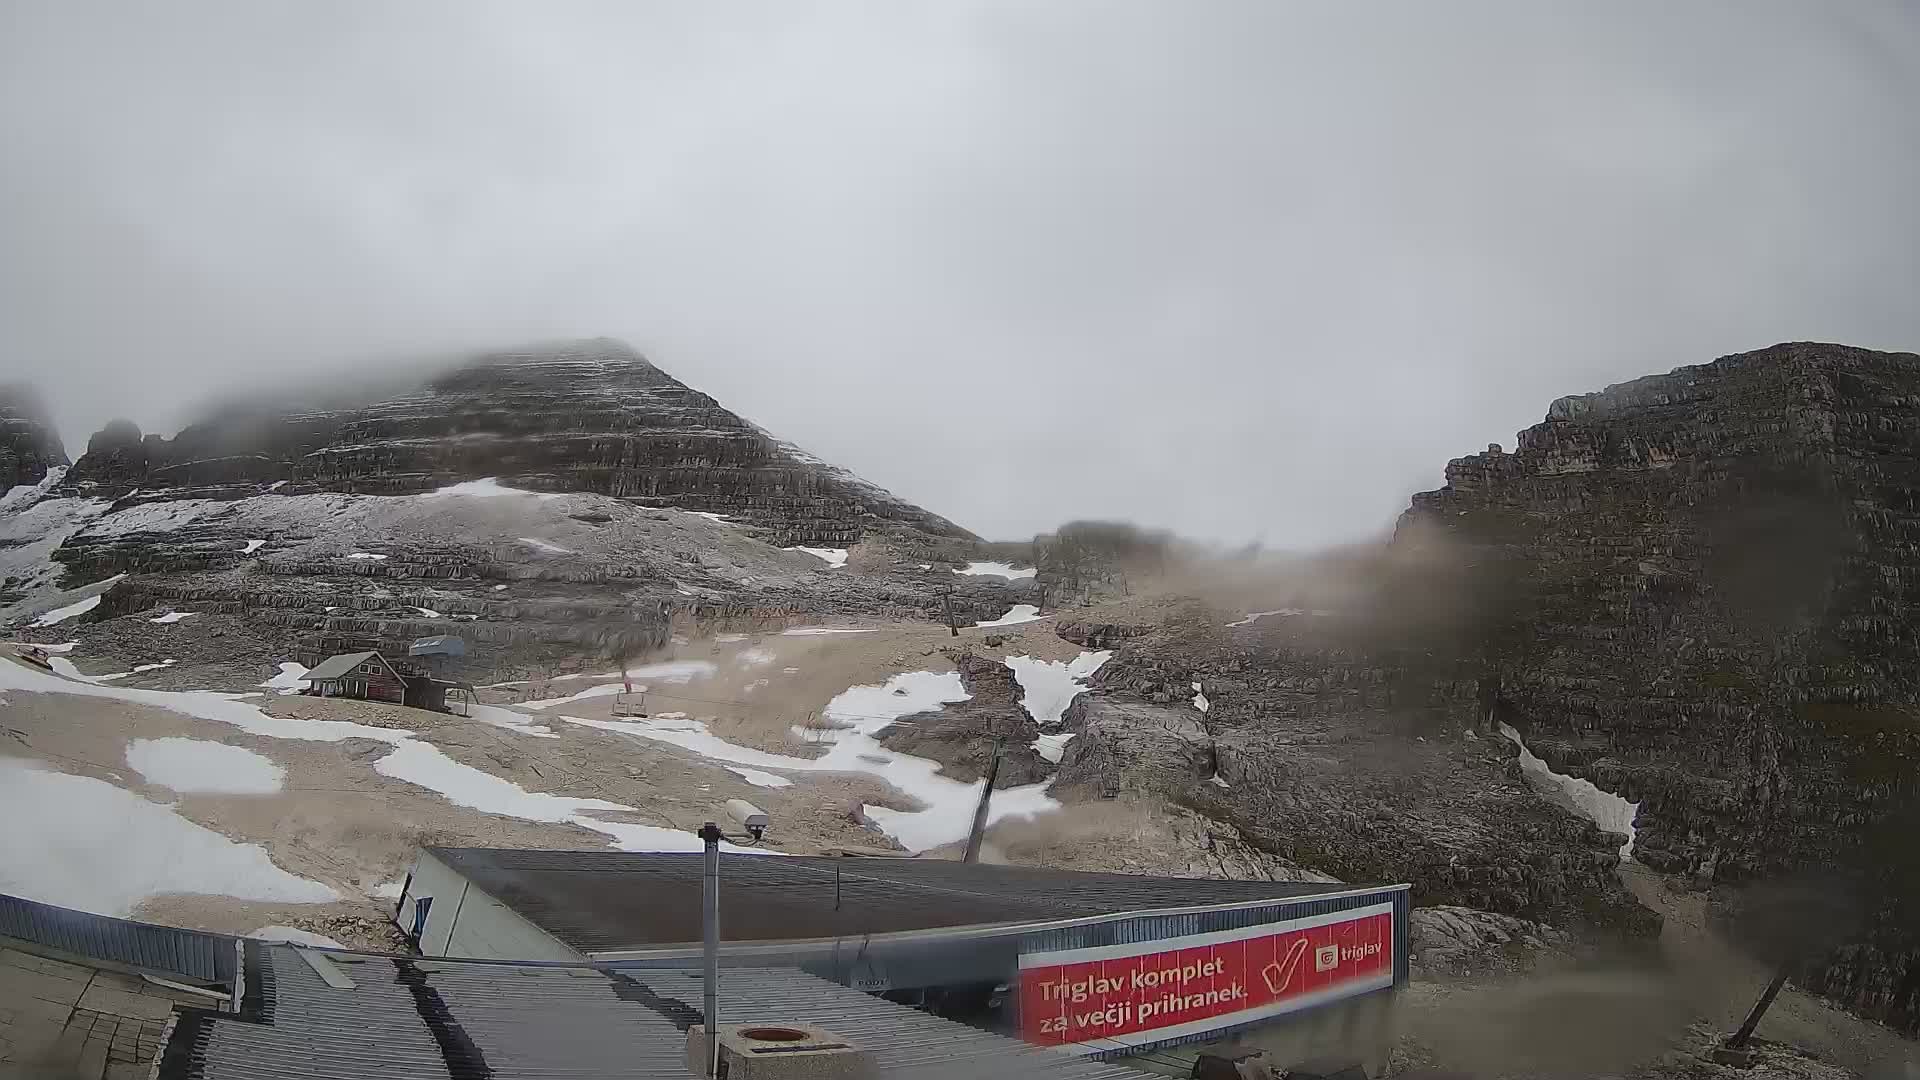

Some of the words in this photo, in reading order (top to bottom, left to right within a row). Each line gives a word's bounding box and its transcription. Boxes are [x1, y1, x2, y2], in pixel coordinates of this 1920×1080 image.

[1341, 942, 1382, 962] triglav
[1039, 975, 1124, 1003] Triglav
[1131, 956, 1224, 990] komplet
[1040, 1014, 1068, 1033] za
[1076, 1001, 1131, 1028] večji
[1138, 981, 1249, 1024] prihranek.
